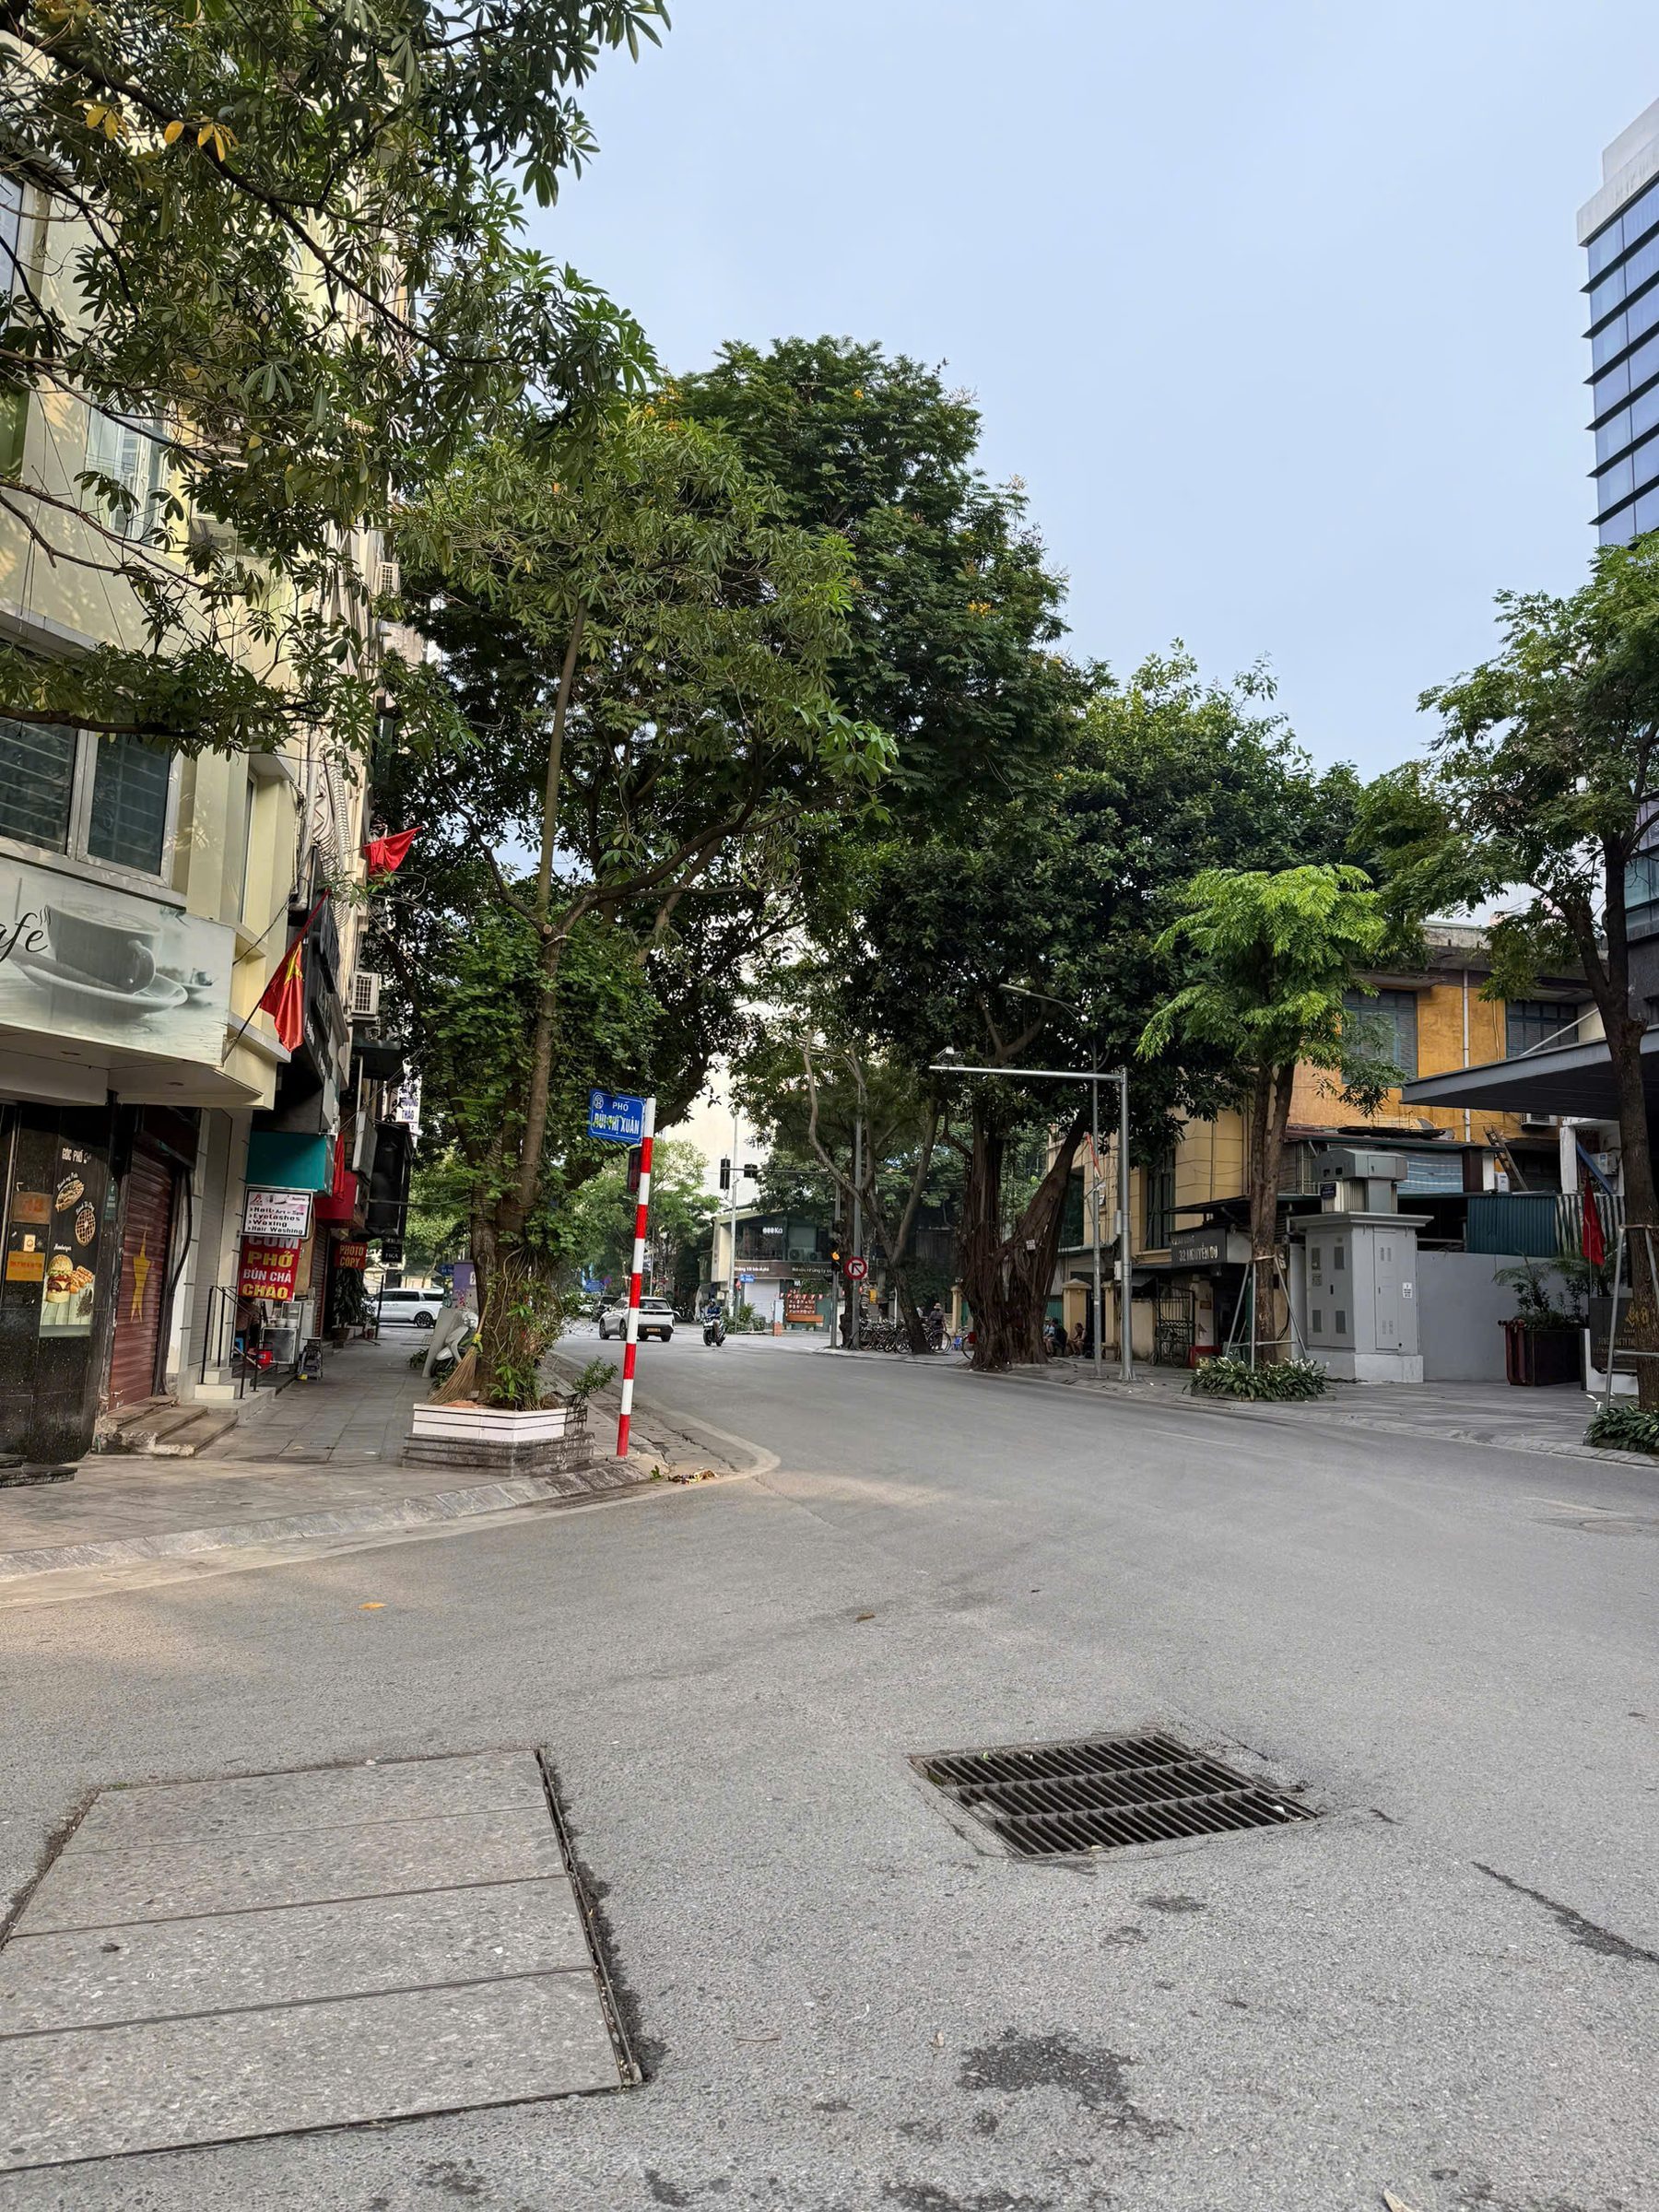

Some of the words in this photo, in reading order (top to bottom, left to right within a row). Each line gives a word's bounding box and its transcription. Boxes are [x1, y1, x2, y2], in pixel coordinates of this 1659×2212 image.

[612, 1101, 629, 1112] PHỐ
[620, 1116, 640, 1135] XUÂN
[253, 1213, 300, 1221] Eyelashes
[269, 1227, 303, 1235] Washing
[339, 1244, 364, 1256] PHOTO
[247, 1250, 294, 1267] PHỞ
[339, 1256, 360, 1267] COPY
[243, 1267, 266, 1280] BÚN
[241, 1283, 288, 1300] CHÁO
